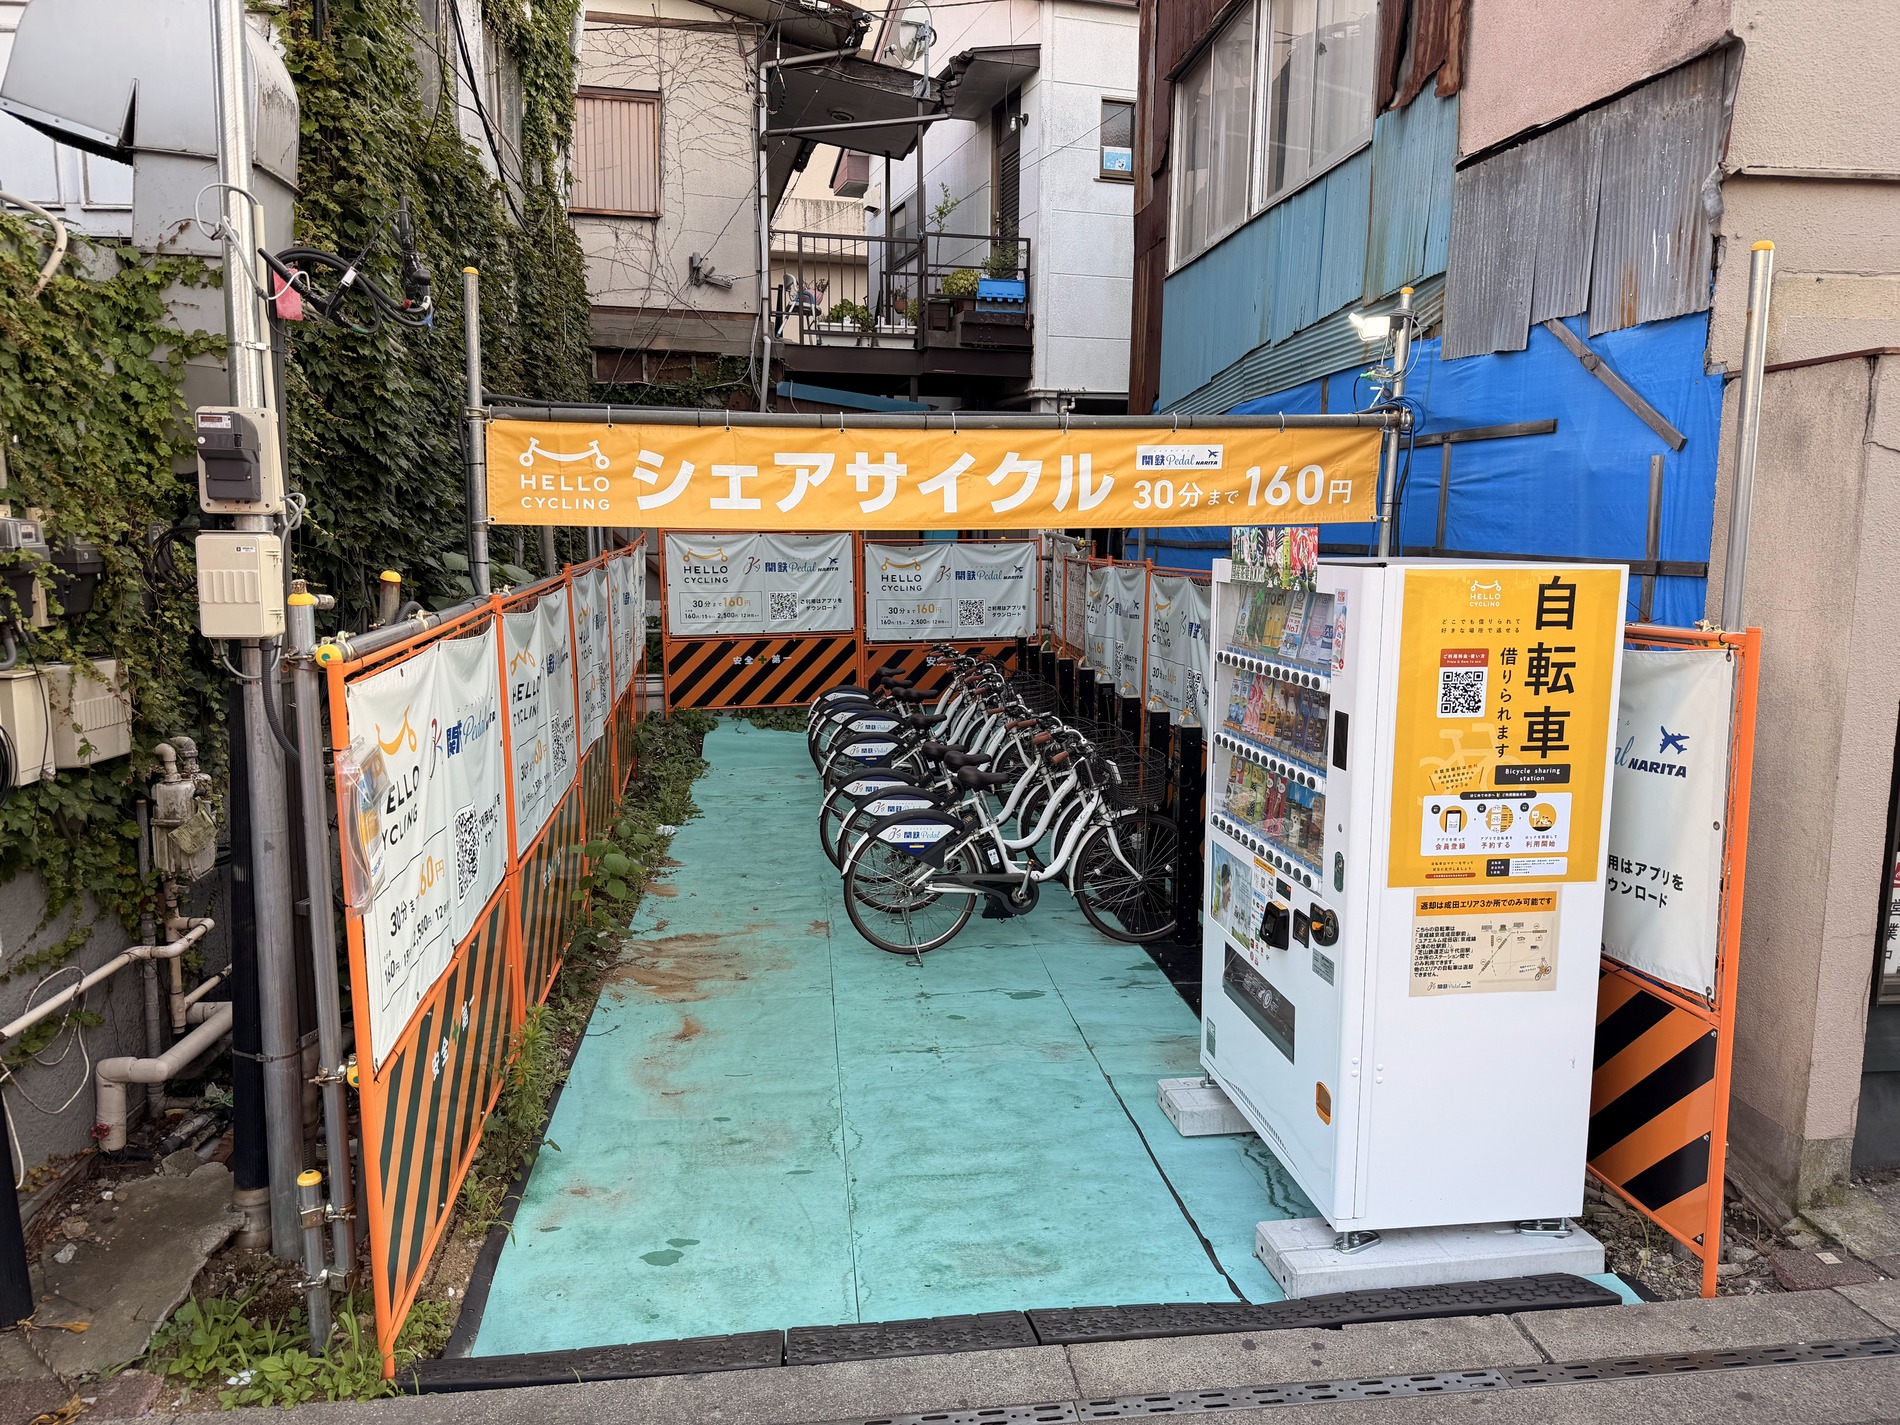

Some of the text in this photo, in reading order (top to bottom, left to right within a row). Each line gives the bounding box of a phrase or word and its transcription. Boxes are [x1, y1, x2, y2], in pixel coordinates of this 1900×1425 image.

[1142, 455, 1165, 466] 関鉄
[1166, 453, 1195, 466] Pedal
[521, 474, 610, 492] HELLO
[632, 449, 1115, 513] シェアサイクル
[1246, 465, 1352, 506] 160円
[521, 497, 610, 510] CYCLING
[683, 565, 728, 574] HELLO
[764, 562, 788, 573] 関鉄
[788, 561, 817, 573] Pedal
[881, 574, 922, 582] HELLO
[977, 570, 1002, 581] Pedal
[733, 656, 754, 665] 安全
[1520, 575, 1577, 759] 自転車
[1495, 647, 1518, 758] 借りられます
[1628, 758, 1686, 778] NARITA
[381, 803, 418, 850] YCLING
[921, 831, 941, 839] Pedal
[1435, 842, 1466, 850] 会員登録
[1481, 841, 1511, 849] 予約する
[1526, 840, 1556, 848] 利用開始
[1420, 897, 1552, 910] 返却は成田エリア3か所でのみ可能です
